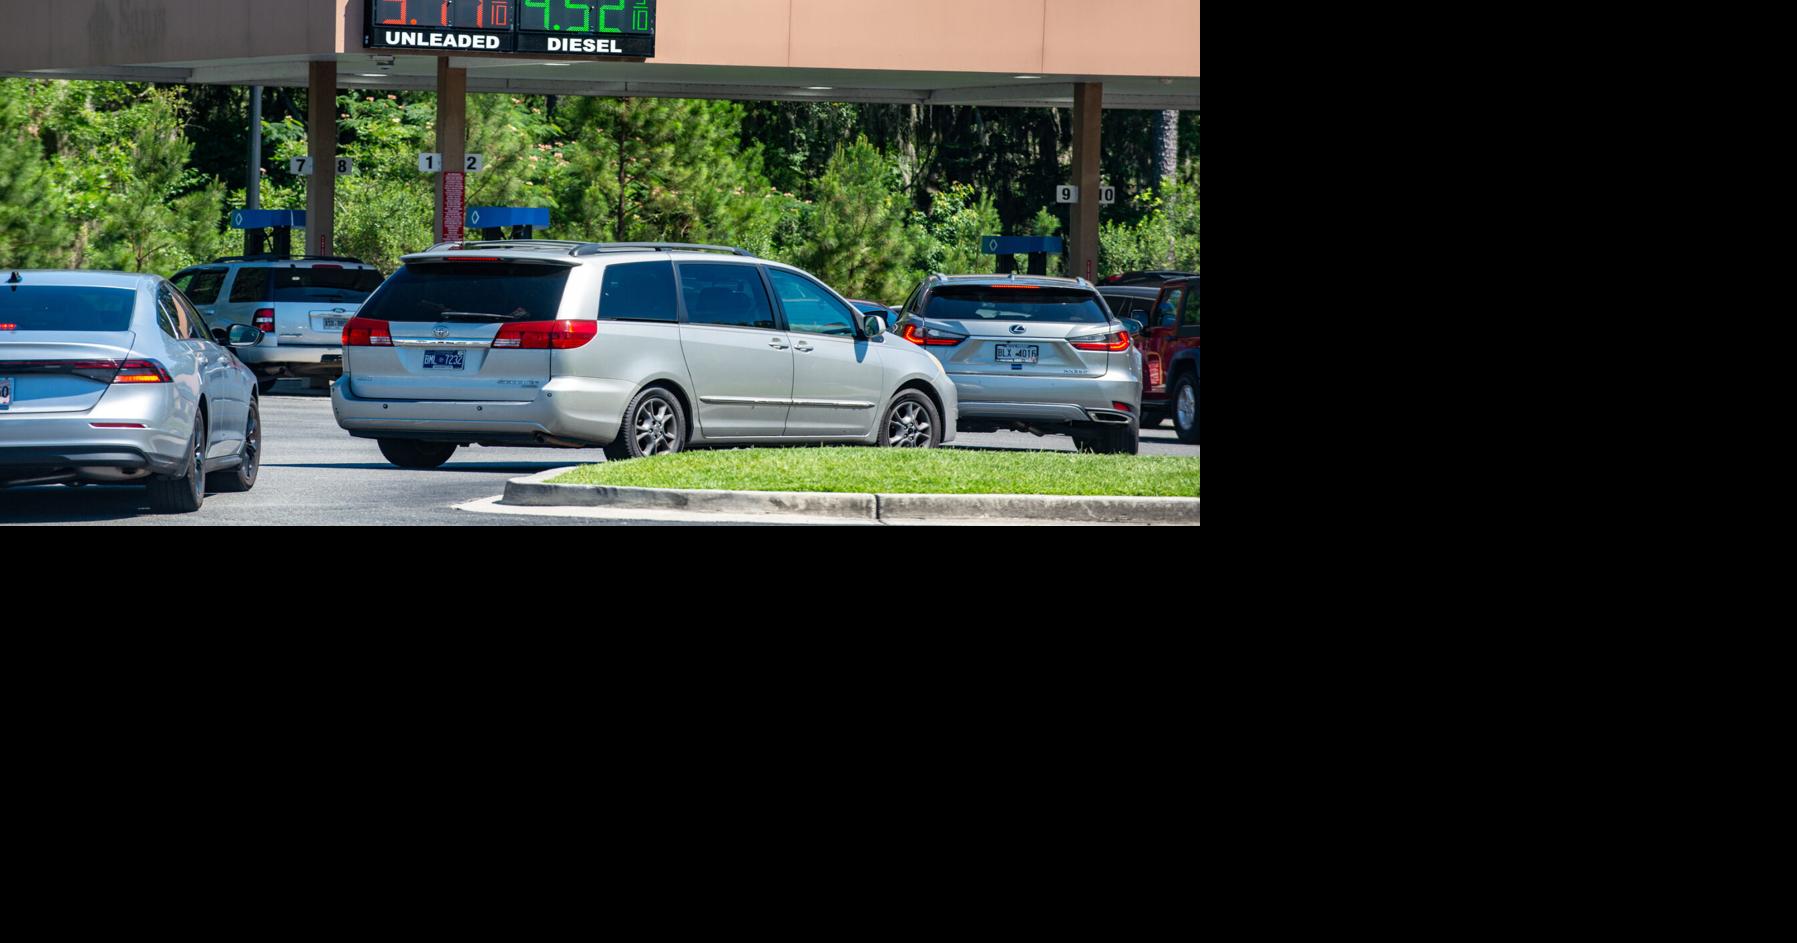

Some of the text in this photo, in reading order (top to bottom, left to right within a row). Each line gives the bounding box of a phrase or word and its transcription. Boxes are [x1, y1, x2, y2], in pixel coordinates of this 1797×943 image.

[385, 31, 500, 49] UNLEADED
[547, 37, 623, 53] DIESEL
[296, 158, 306, 172] 7
[337, 159, 347, 172] 8
[426, 155, 433, 169] 1
[466, 156, 477, 170] 2
[1062, 187, 1071, 200] 9
